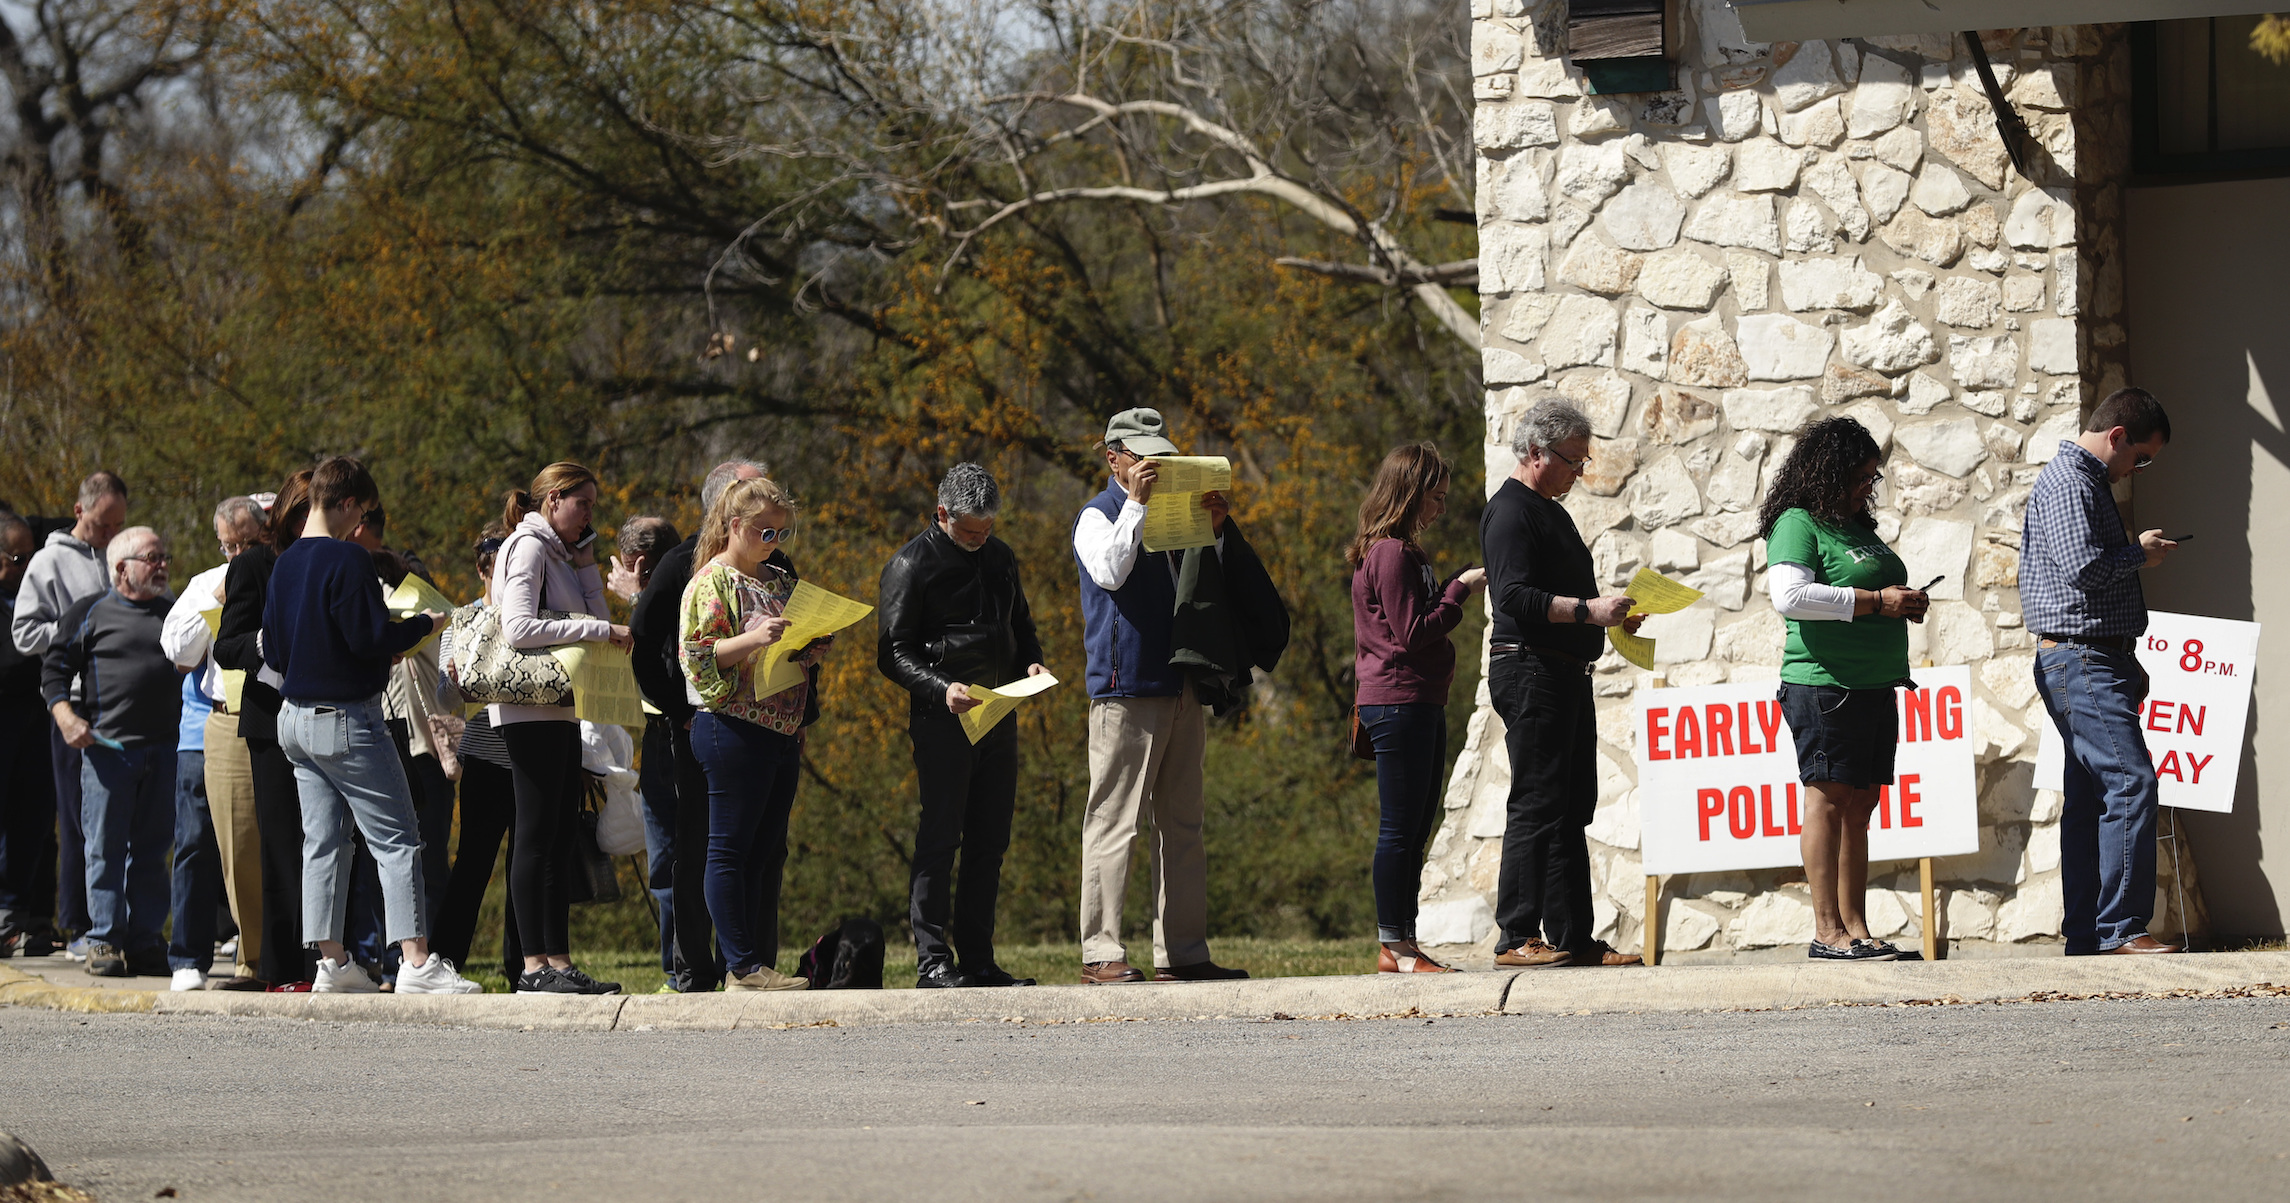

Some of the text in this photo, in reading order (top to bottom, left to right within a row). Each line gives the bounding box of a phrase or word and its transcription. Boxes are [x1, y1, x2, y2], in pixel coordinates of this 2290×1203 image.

[2147, 635, 2168, 652] to
[1646, 685, 1963, 761] EARLY NG
[2137, 699, 2207, 736] EN
[2147, 749, 2214, 785] AY
[1697, 783, 1803, 842] POLL
